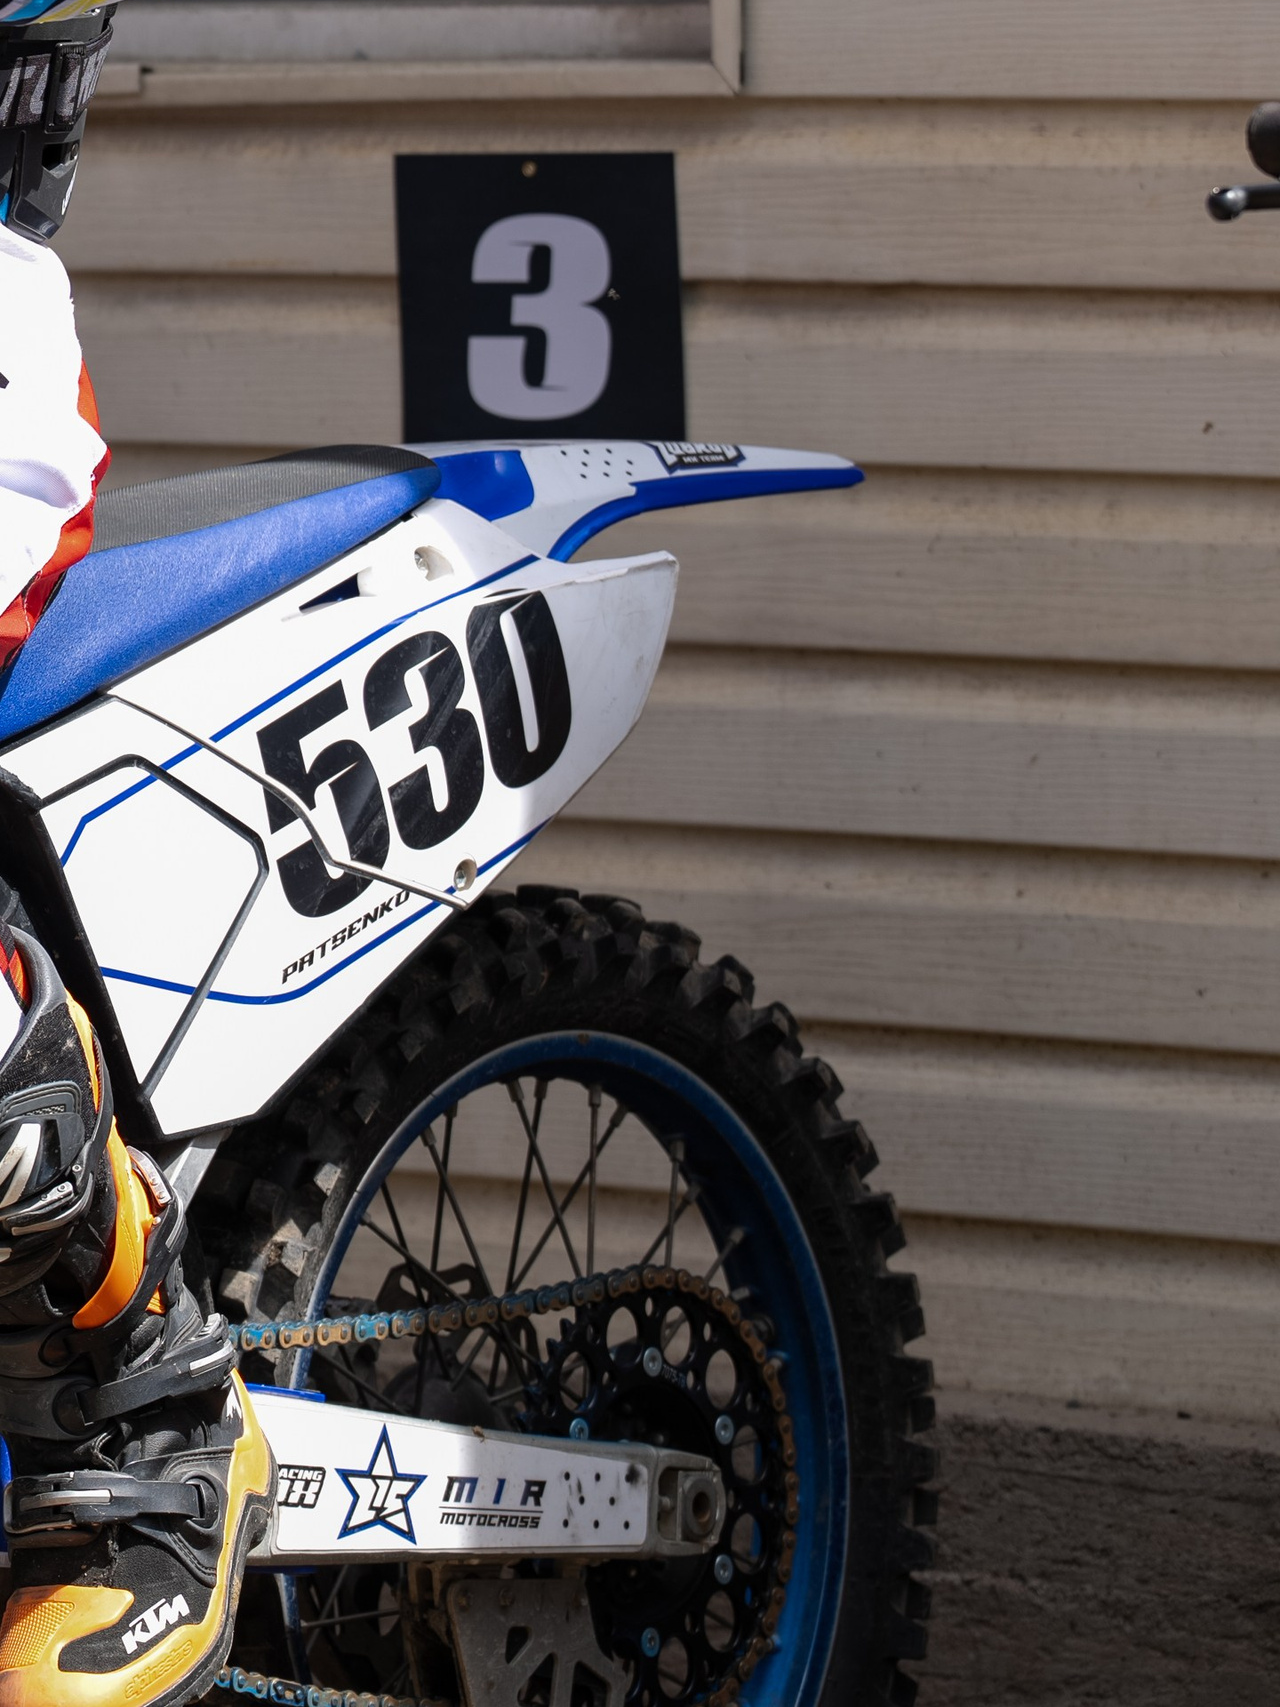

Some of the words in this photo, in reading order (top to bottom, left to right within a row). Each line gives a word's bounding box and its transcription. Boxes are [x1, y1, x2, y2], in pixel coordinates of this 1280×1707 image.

[466, 213, 613, 421] 3
[256, 588, 572, 919] 530
[281, 890, 411, 985] PATSENKO
[278, 1467, 324, 1482] ACING
[442, 1474, 548, 1507] MIR
[439, 1511, 542, 1529] MOTOCROSS
[121, 1593, 190, 1655] KTM
